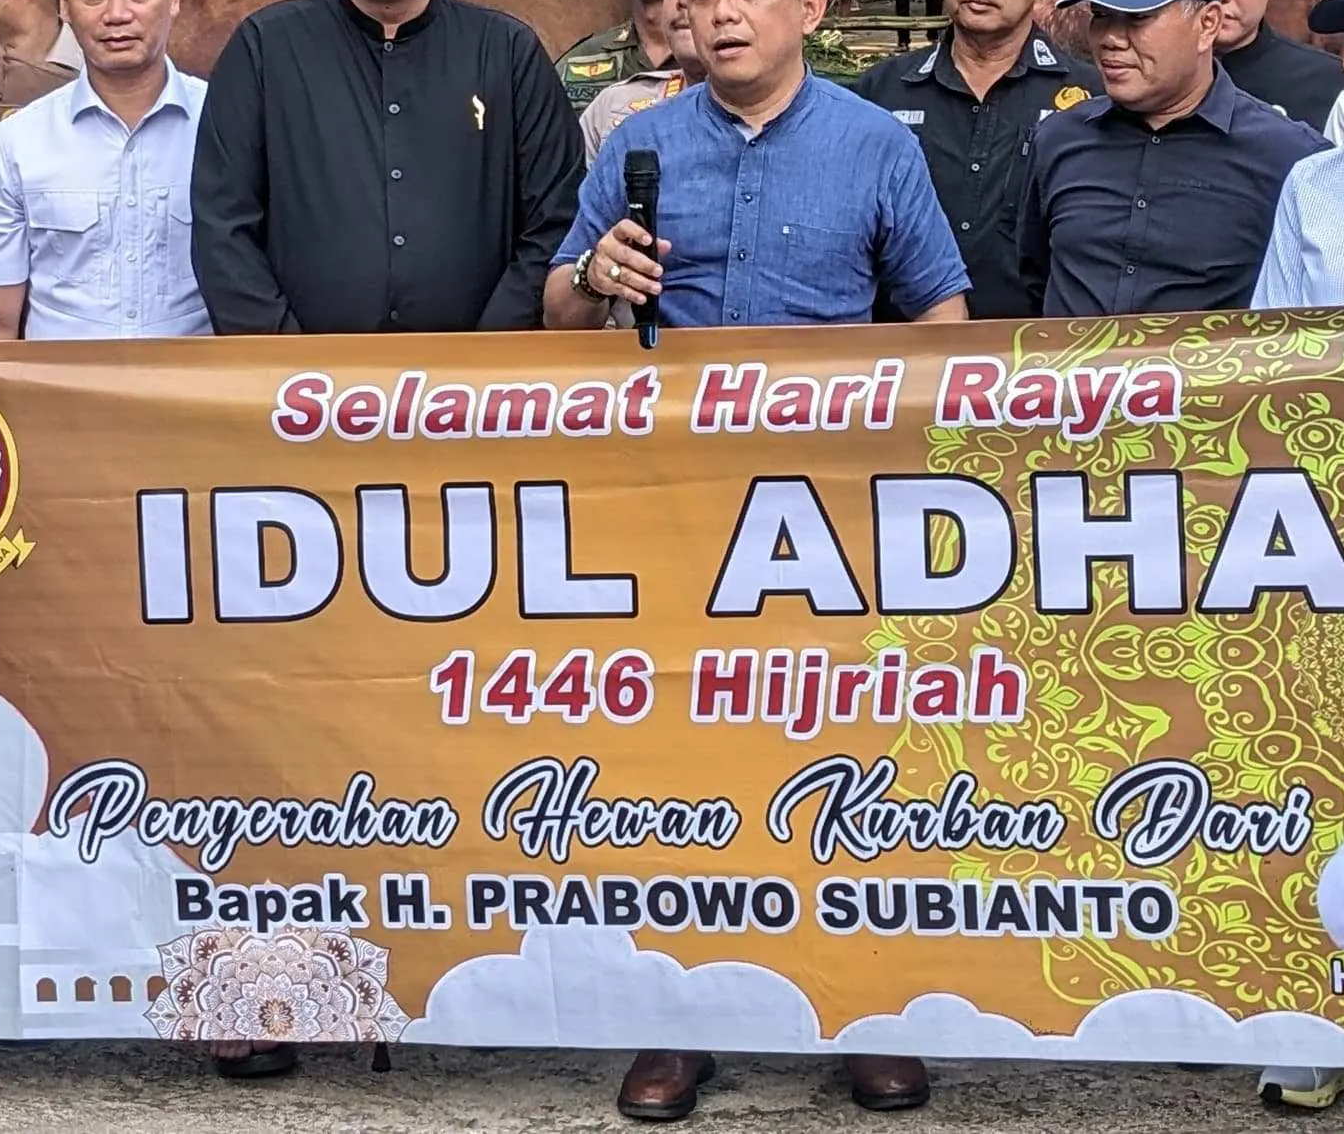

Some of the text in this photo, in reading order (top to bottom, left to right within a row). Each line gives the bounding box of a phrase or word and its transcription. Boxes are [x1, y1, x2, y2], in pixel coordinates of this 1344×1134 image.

[272, 359, 1181, 439] Selamat Hari Raya
[136, 479, 639, 624] IDUL
[431, 649, 1023, 736] 1446 Hijriah
[51, 755, 1315, 870] Penyerahan Hewan Kurban Dari
[175, 877, 1174, 934] Bapak H. PRABOWO SUBIANTO
